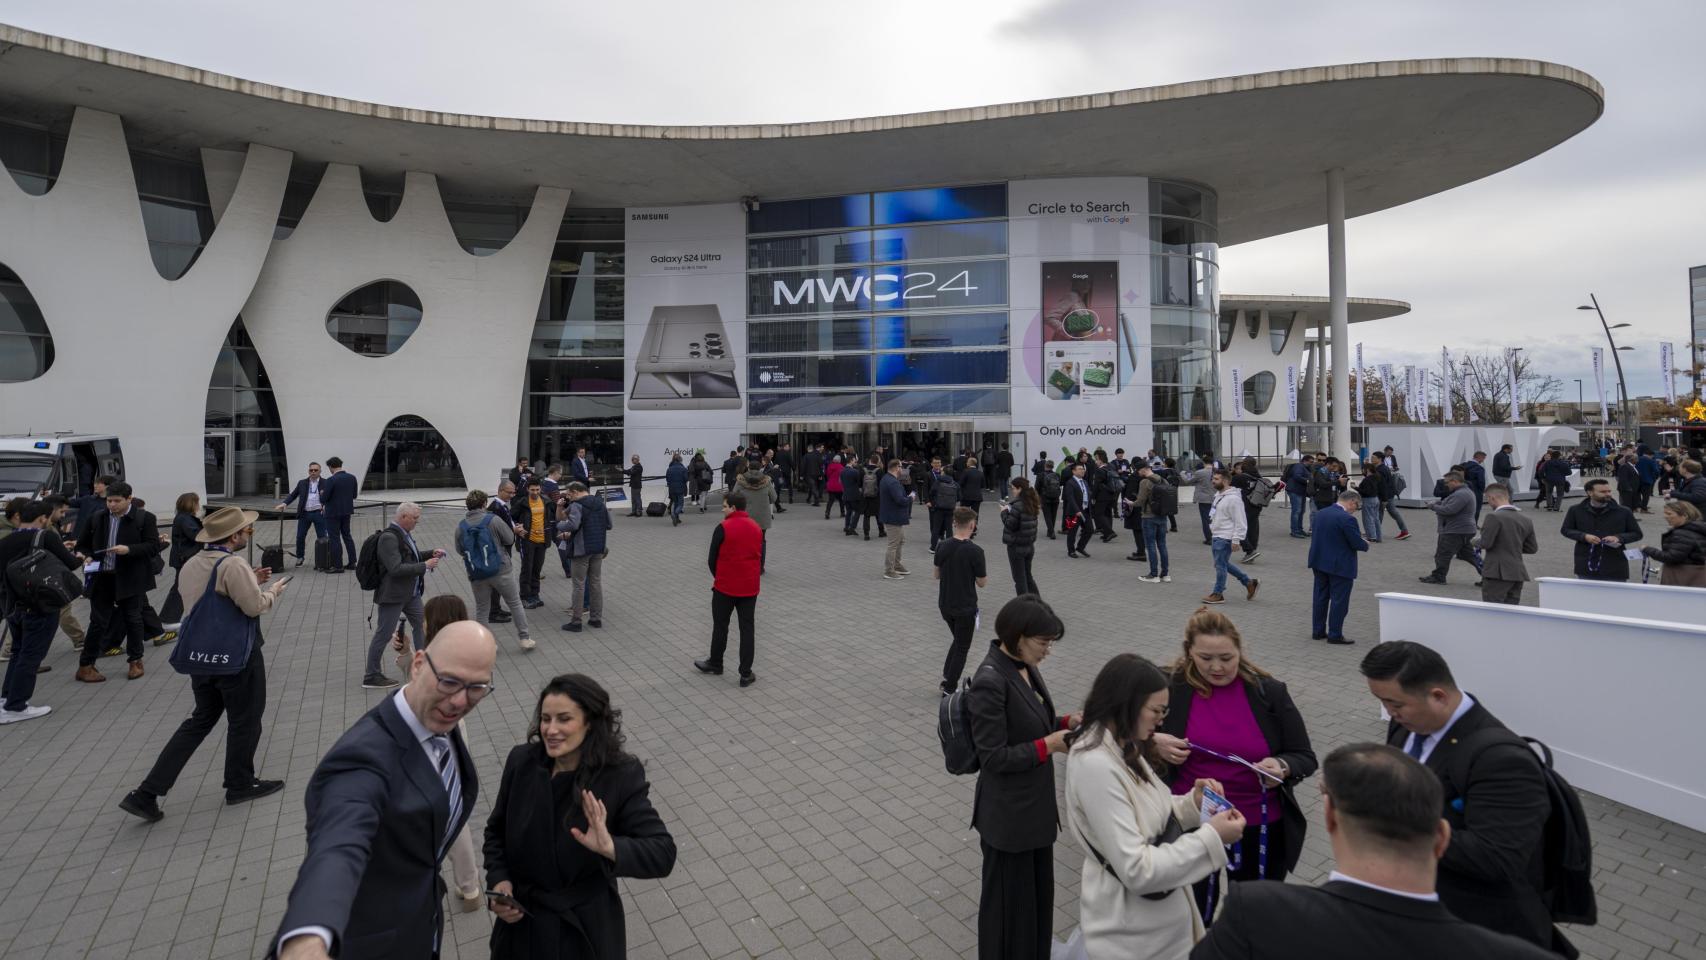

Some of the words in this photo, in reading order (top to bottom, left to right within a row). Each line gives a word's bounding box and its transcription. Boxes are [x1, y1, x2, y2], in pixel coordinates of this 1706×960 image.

[1028, 203, 1067, 215] Circle
[1070, 203, 1083, 213] to
[1086, 201, 1130, 213] Search
[631, 213, 669, 221] SAMSUNG
[1086, 216, 1102, 224] with
[1103, 215, 1130, 225] Google
[650, 254, 683, 264] Galaxy
[683, 254, 699, 262] S24
[700, 253, 721, 262] Ultra
[773, 270, 978, 306] MWC24
[1039, 426, 1066, 438] Only
[1068, 428, 1082, 436] on
[1084, 425, 1126, 436] Android
[664, 447, 694, 456] Android
[189, 650, 230, 665] LYLE'S
